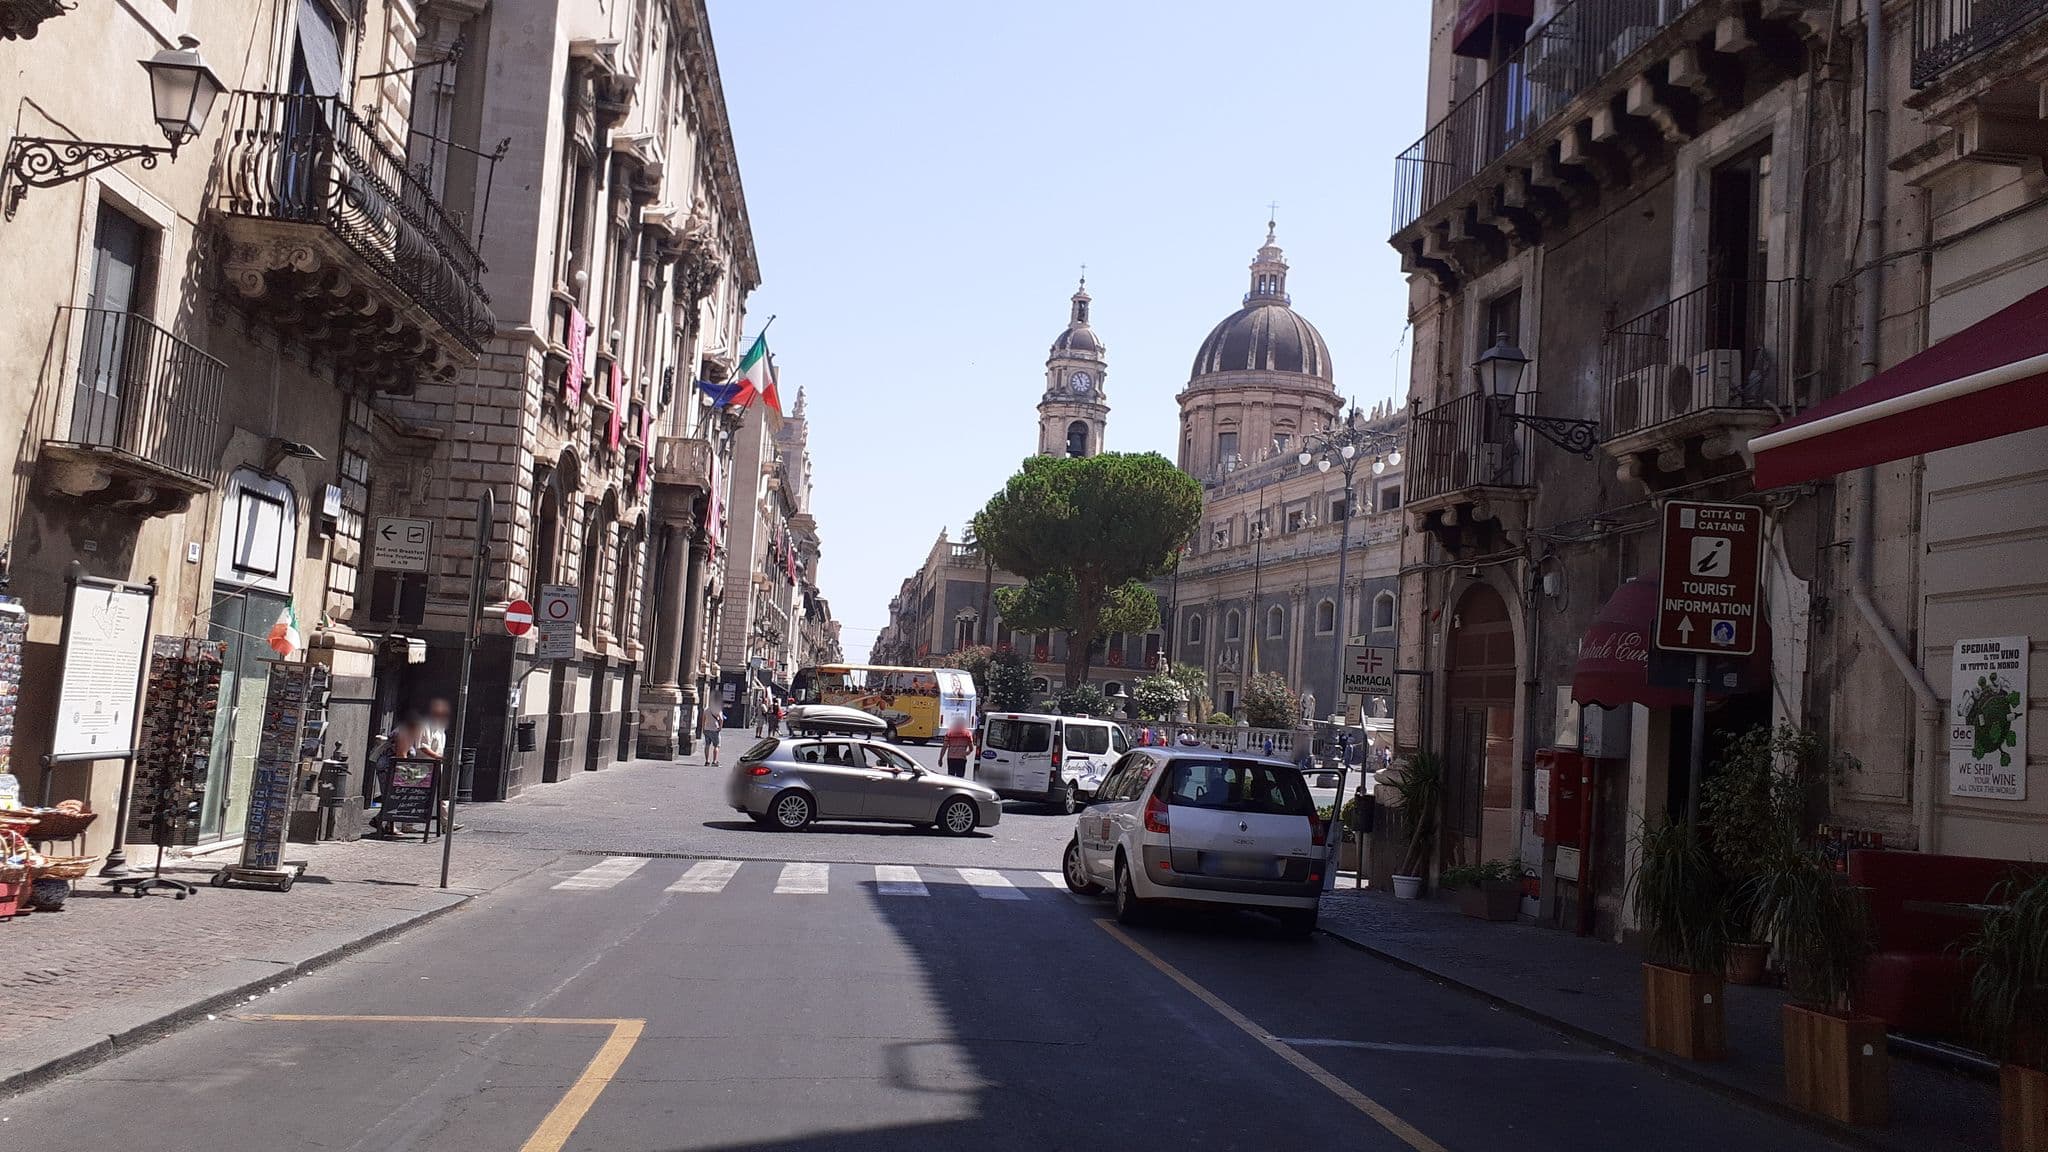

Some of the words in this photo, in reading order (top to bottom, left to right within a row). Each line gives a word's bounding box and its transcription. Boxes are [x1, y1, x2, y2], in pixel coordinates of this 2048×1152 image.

[1735, 512, 1746, 520] DI
[1699, 521, 1745, 532] CATANIA
[1682, 581, 1736, 597] TOURIST
[1665, 599, 1751, 616] INFORMATION
[1961, 643, 2000, 654] SPEDIAMO
[2001, 649, 2020, 660] VINO
[1968, 663, 1988, 671] TUTTO
[1997, 661, 2019, 670] MONDO
[1345, 675, 1391, 687] FARMACIA
[1959, 763, 1972, 774] WE
[1974, 763, 1993, 775] SHIP
[1992, 773, 2016, 787] WINE
